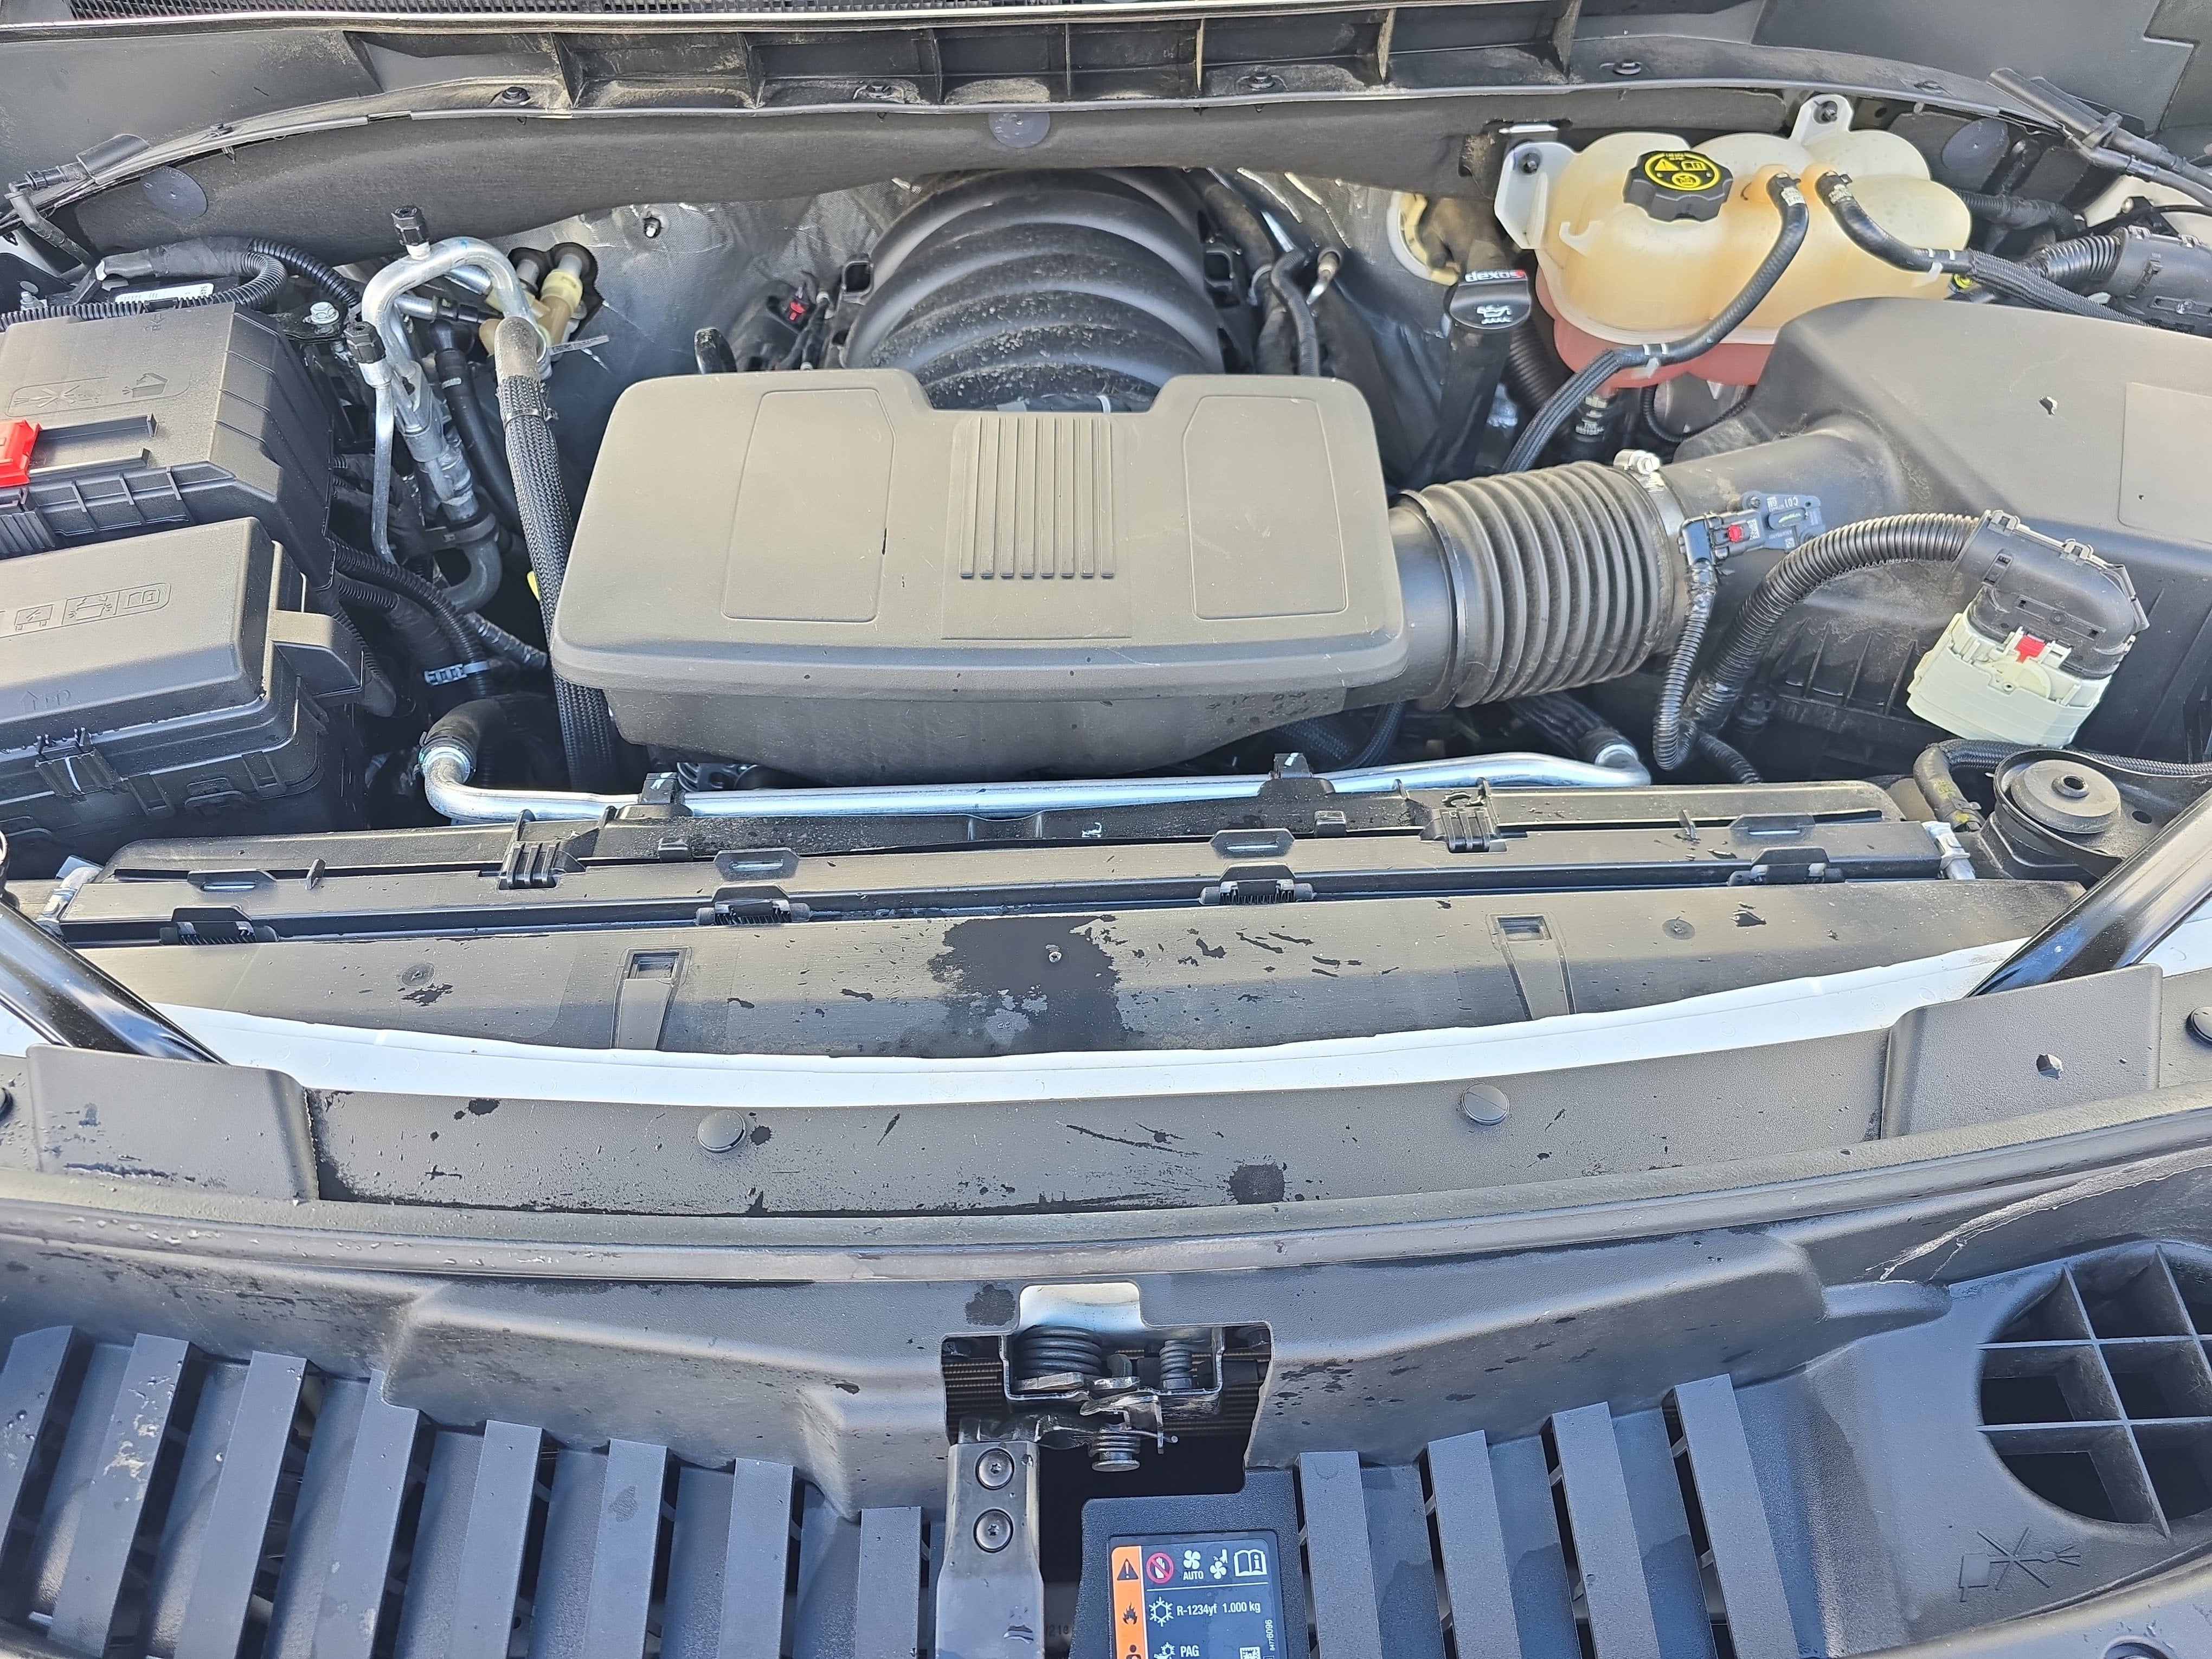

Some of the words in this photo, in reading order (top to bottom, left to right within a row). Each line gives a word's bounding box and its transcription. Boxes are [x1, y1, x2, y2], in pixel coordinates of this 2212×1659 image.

[1182, 1571, 1204, 1580] AUTO
[1176, 1603, 1218, 1617] R-1234yf
[1222, 1602, 1247, 1613] 1.000
[1249, 1601, 1261, 1613] kg
[1264, 1619, 1276, 1651] 84776096
[1180, 1645, 1200, 1657] PAG
